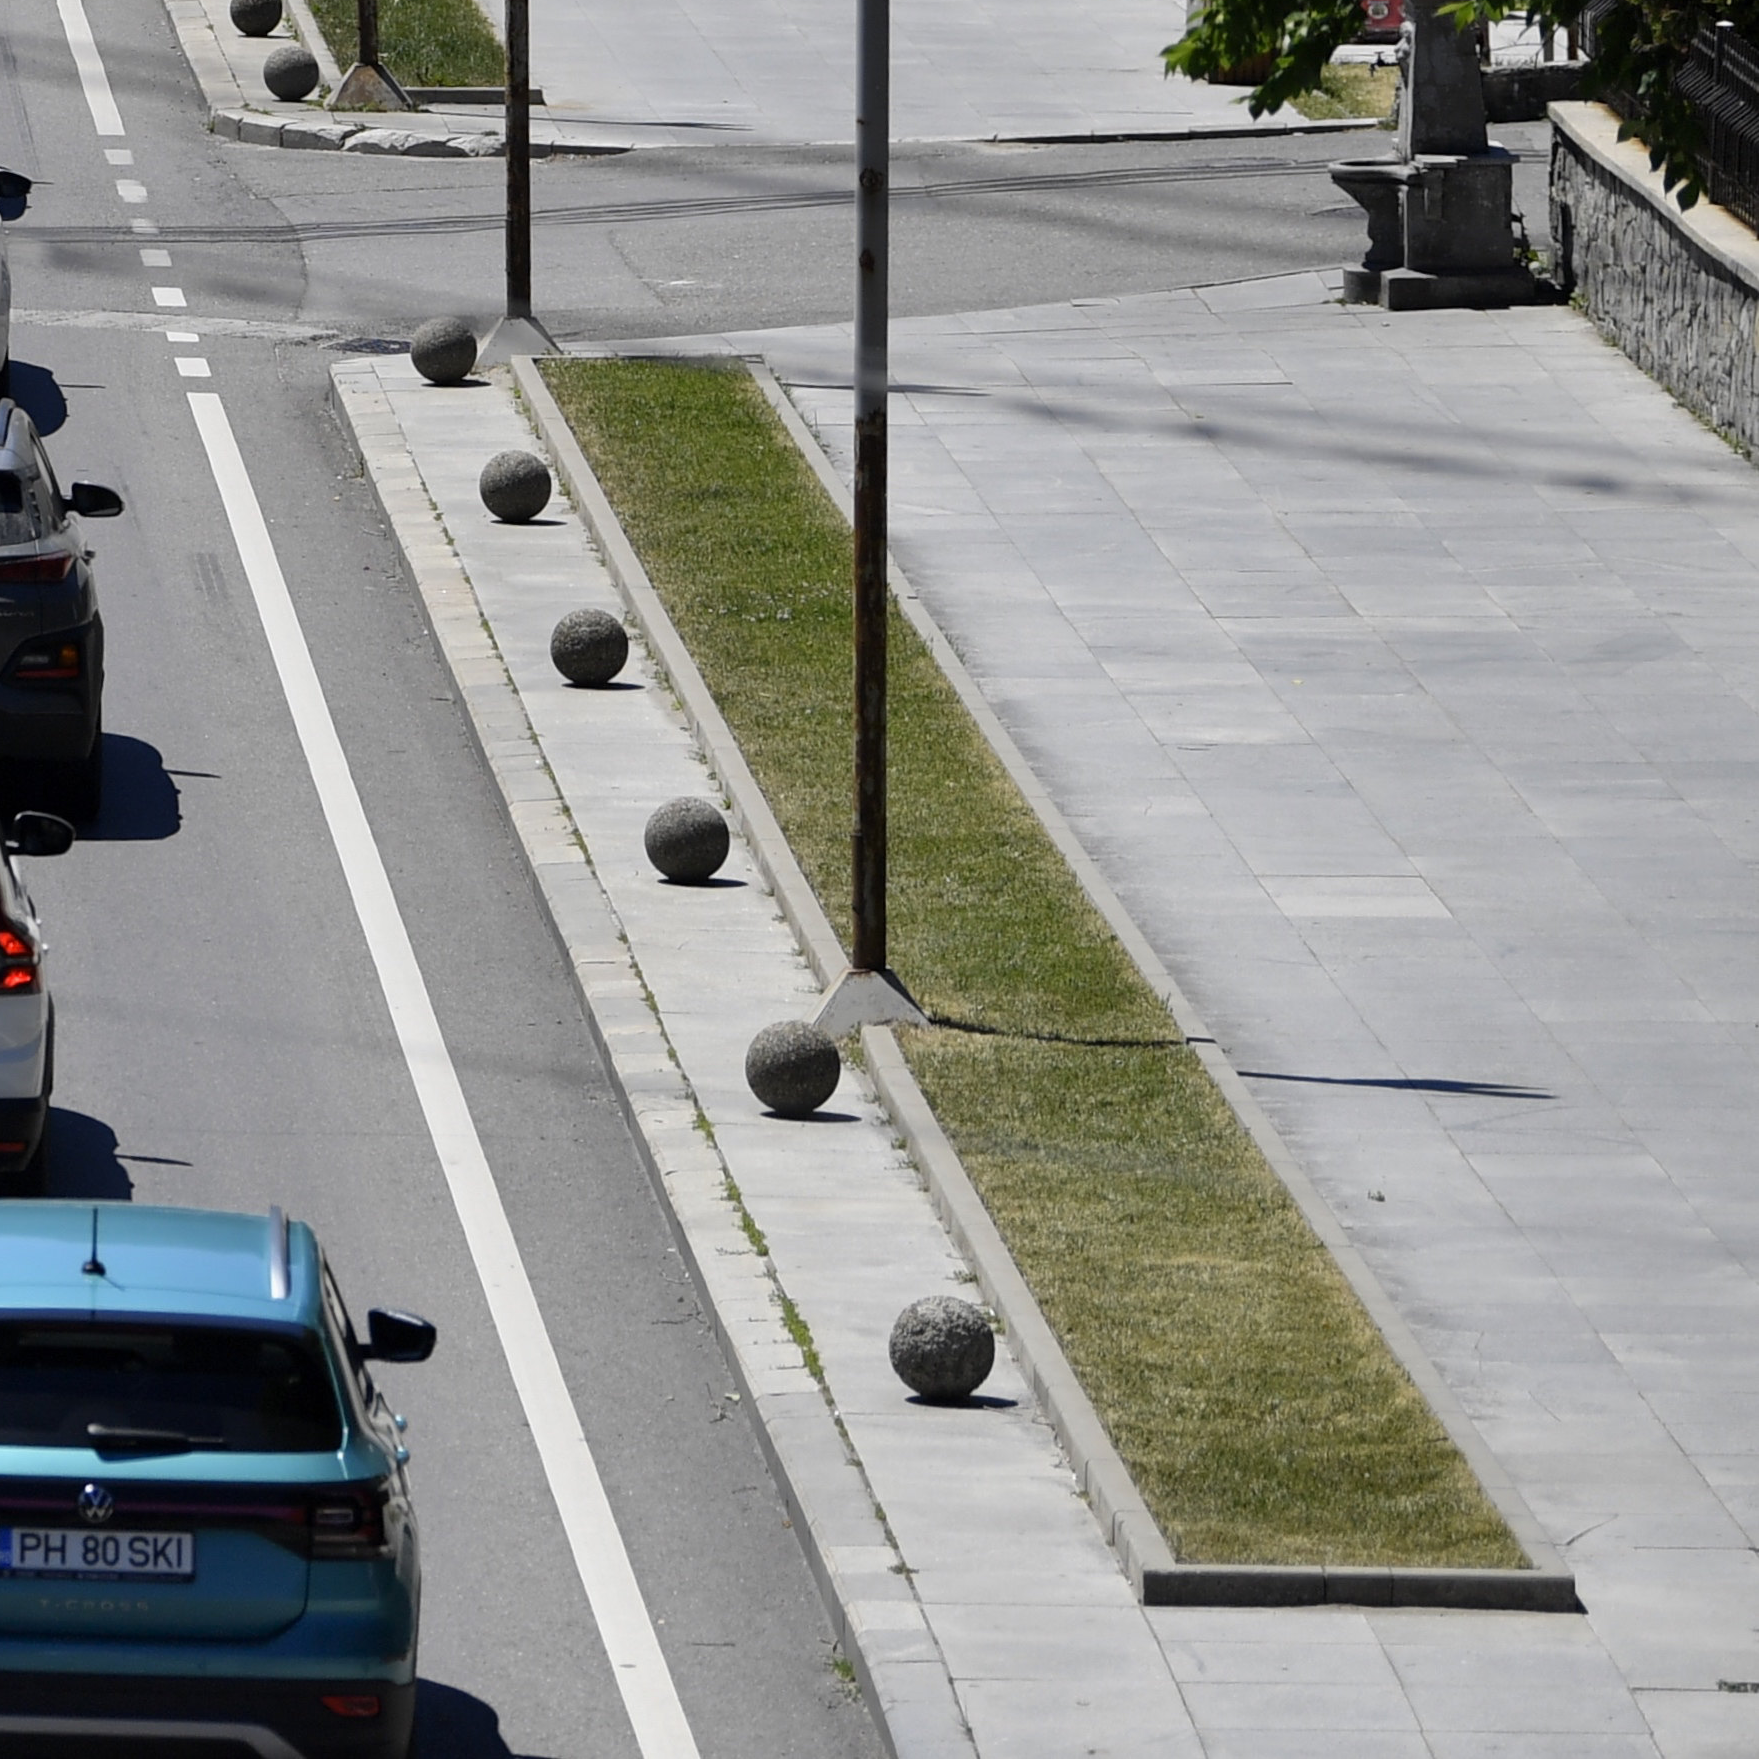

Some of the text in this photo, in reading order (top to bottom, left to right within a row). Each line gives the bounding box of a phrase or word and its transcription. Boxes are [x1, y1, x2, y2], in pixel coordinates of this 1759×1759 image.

[20, 1534, 183, 1568] PH 80 SKI
